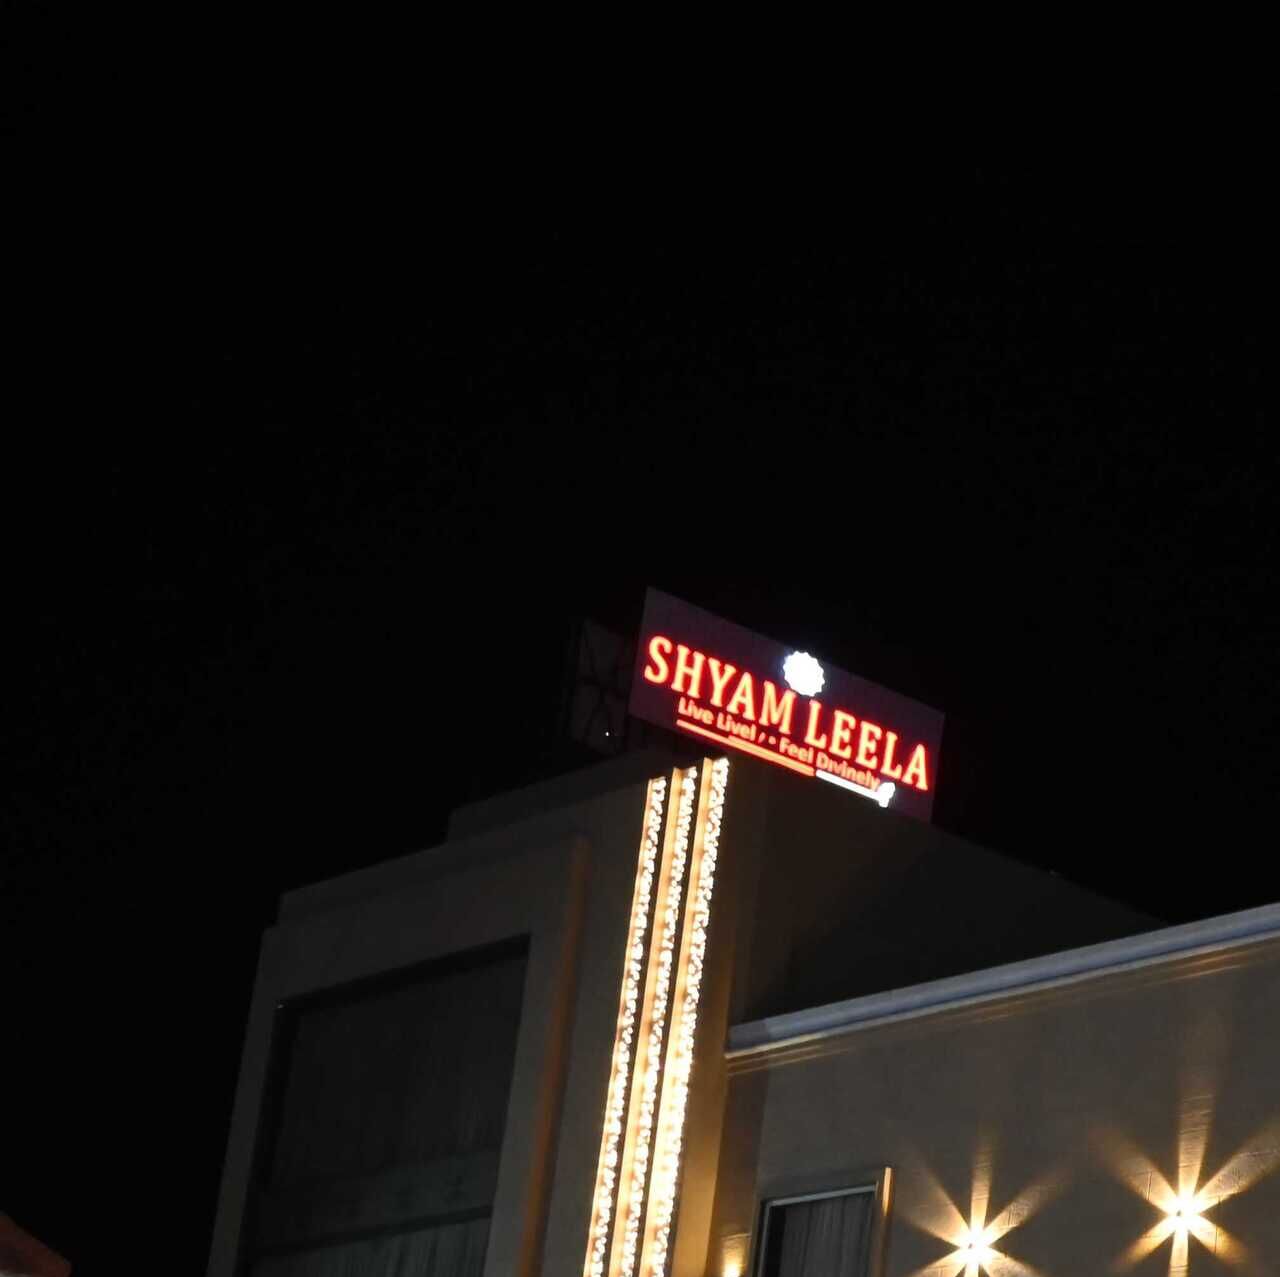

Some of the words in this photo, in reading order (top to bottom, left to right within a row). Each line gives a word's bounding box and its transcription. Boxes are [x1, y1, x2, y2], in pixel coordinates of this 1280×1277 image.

[644, 635, 798, 735] SHYAM
[804, 699, 929, 791] LEELA
[678, 697, 714, 725] Live
[779, 736, 814, 763] Feel
